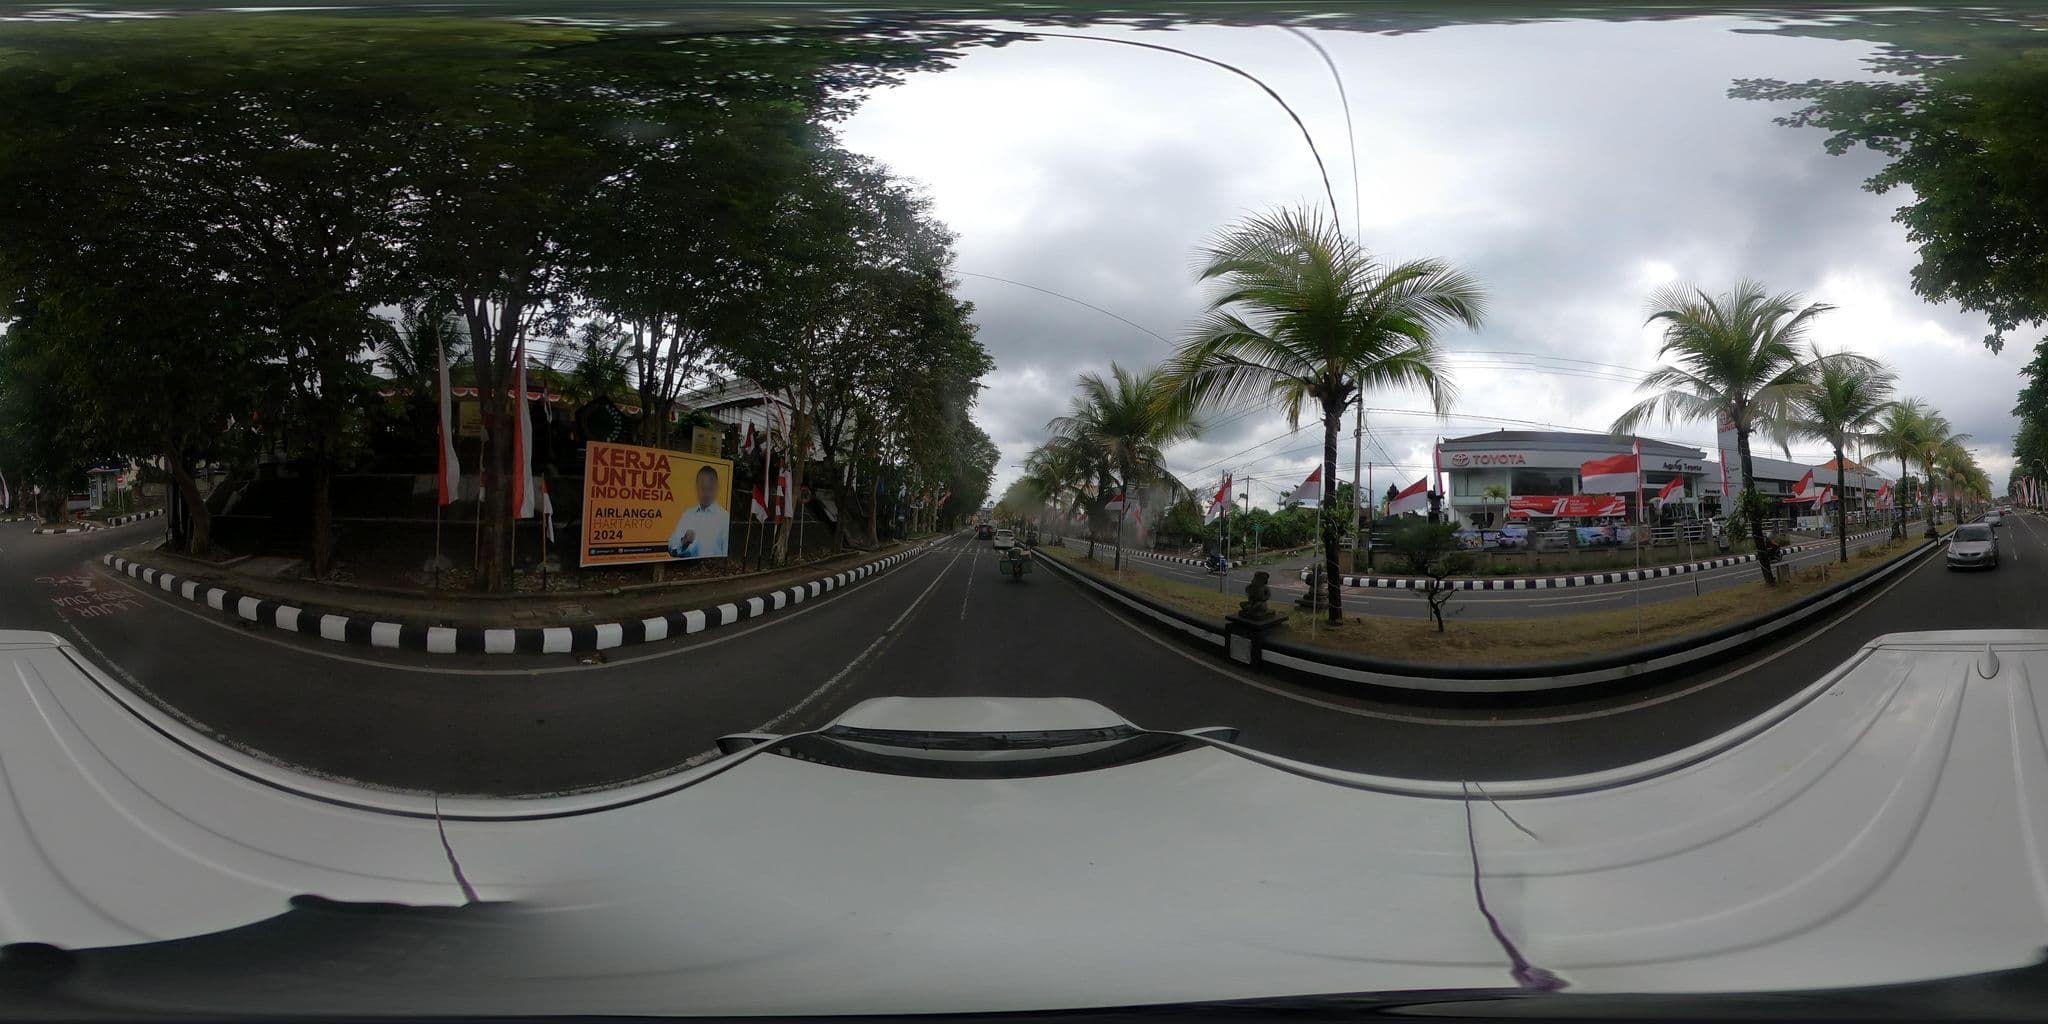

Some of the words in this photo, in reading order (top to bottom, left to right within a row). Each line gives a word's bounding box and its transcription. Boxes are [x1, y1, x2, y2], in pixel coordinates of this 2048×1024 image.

[593, 446, 671, 472] KERJA
[1472, 453, 1526, 465] TOYOTA
[592, 466, 671, 490] UNTUK
[591, 486, 674, 502] INDONESIA
[595, 507, 663, 519] AIRLANGGA
[594, 518, 653, 529] HARTARTO
[594, 530, 623, 540] 2024
